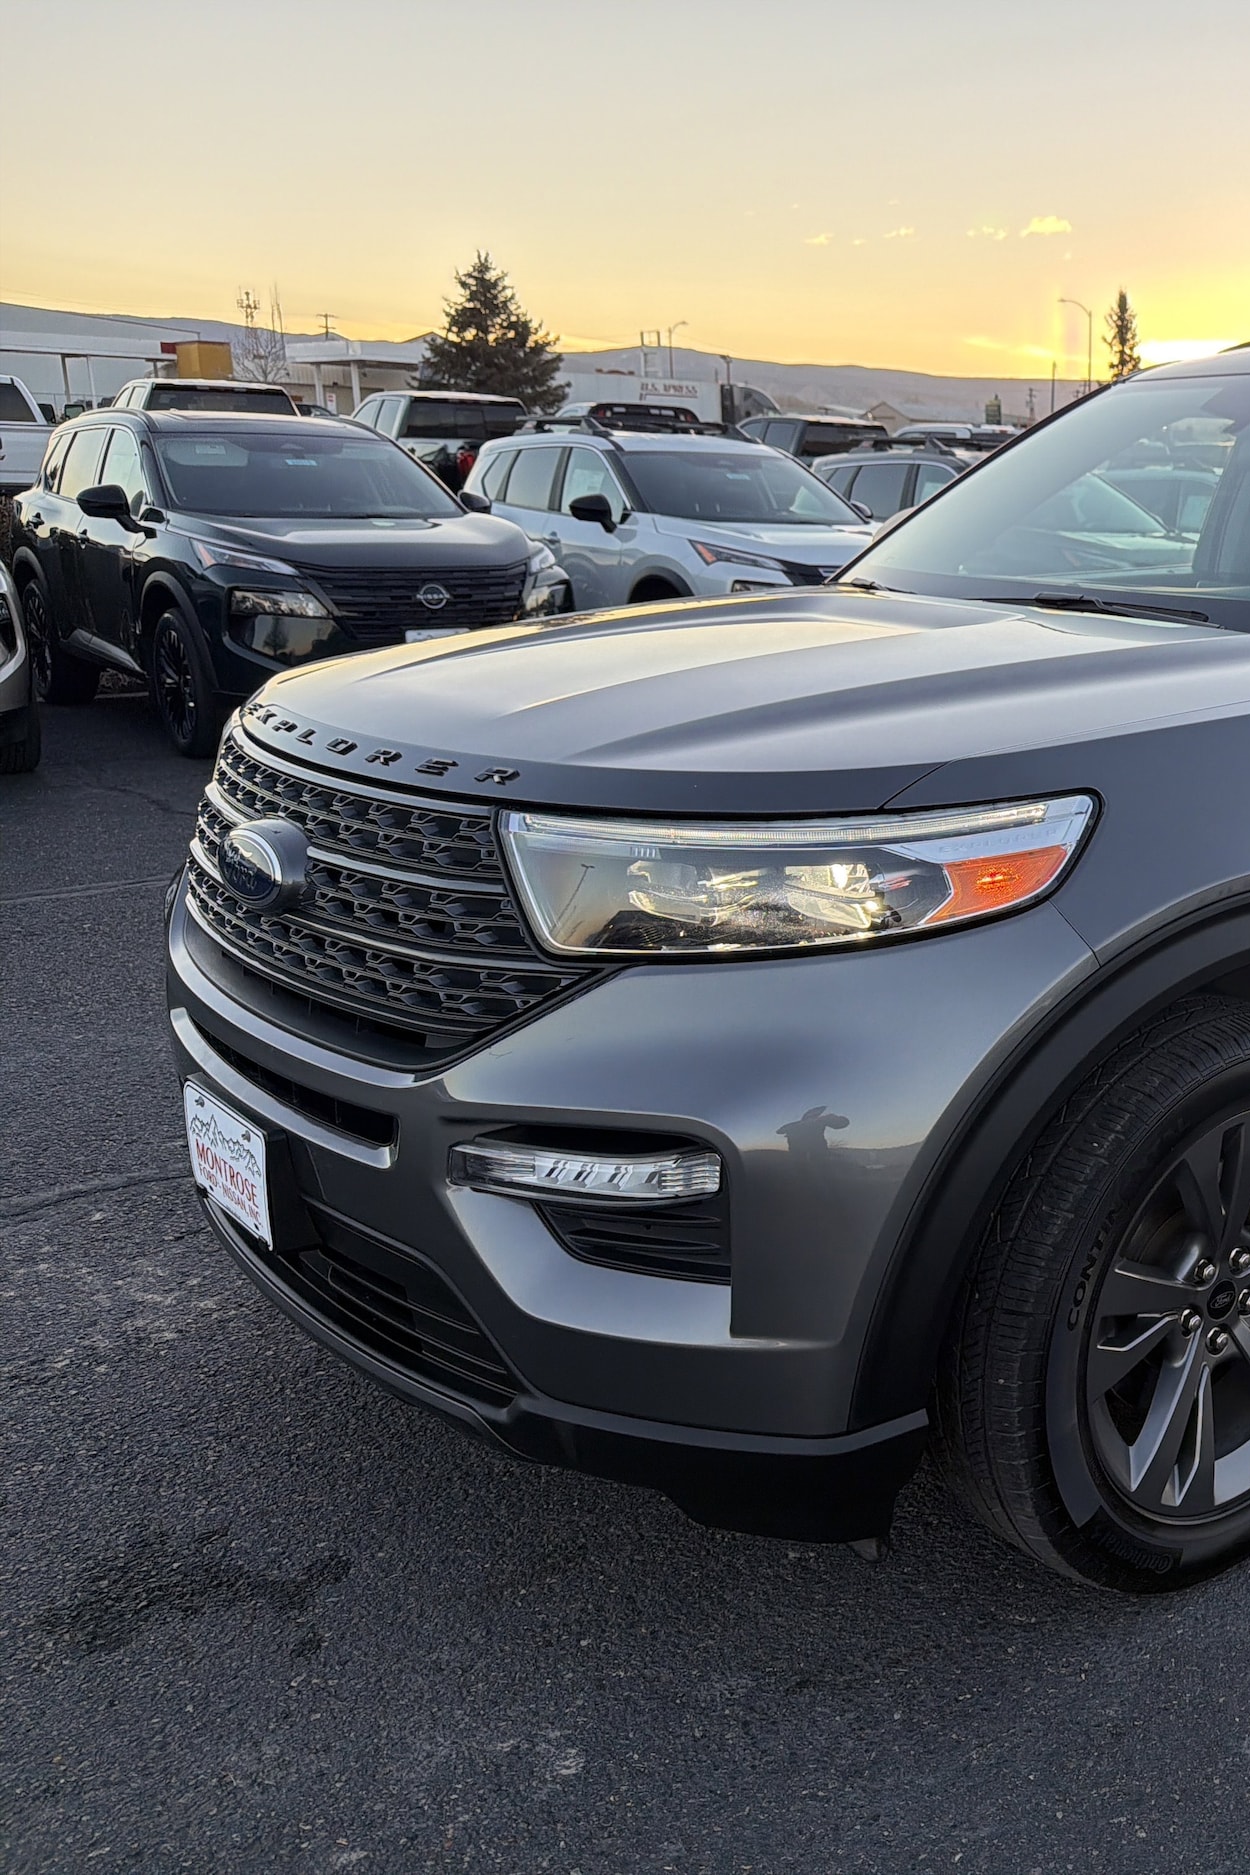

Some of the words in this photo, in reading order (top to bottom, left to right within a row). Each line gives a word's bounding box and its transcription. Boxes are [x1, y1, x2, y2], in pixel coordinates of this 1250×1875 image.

[244, 702, 521, 786] EXPLORER
[195, 1137, 260, 1209] MONTROSE
[198, 1162, 218, 1189] FORD
